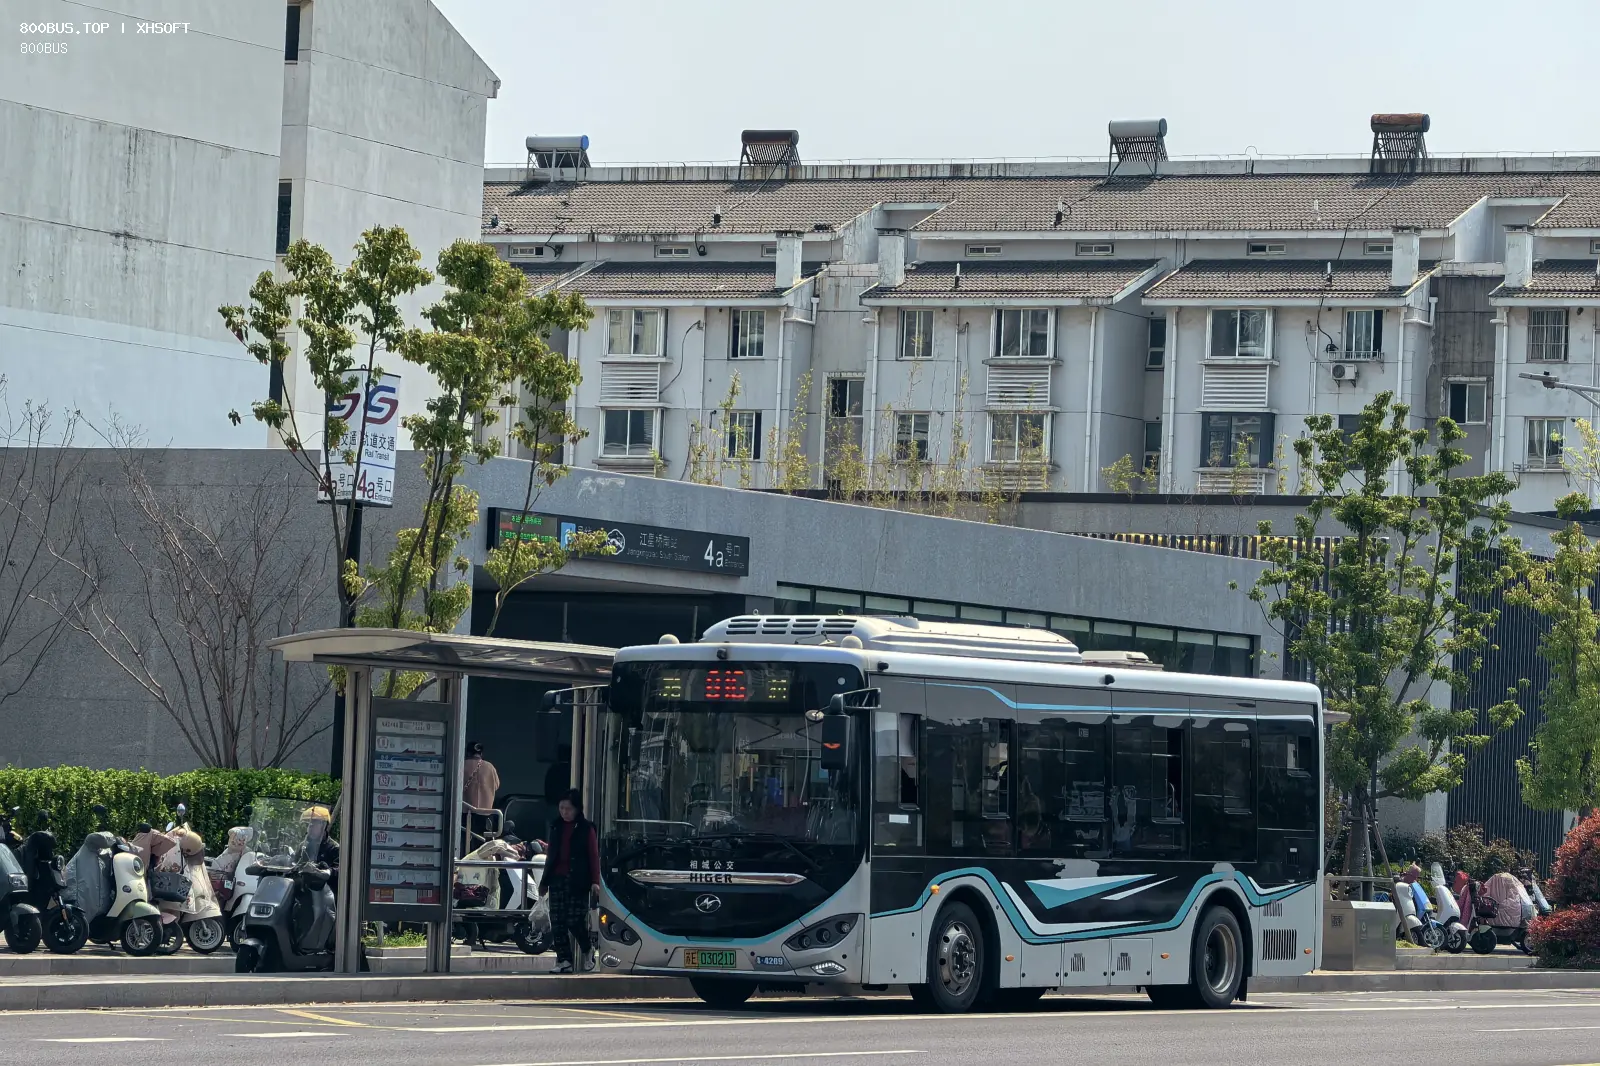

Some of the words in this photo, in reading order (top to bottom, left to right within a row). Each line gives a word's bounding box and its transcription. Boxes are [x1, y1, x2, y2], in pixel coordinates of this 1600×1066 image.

[690, 860, 734, 870] 相城公交
[689, 873, 733, 883] HIGER
